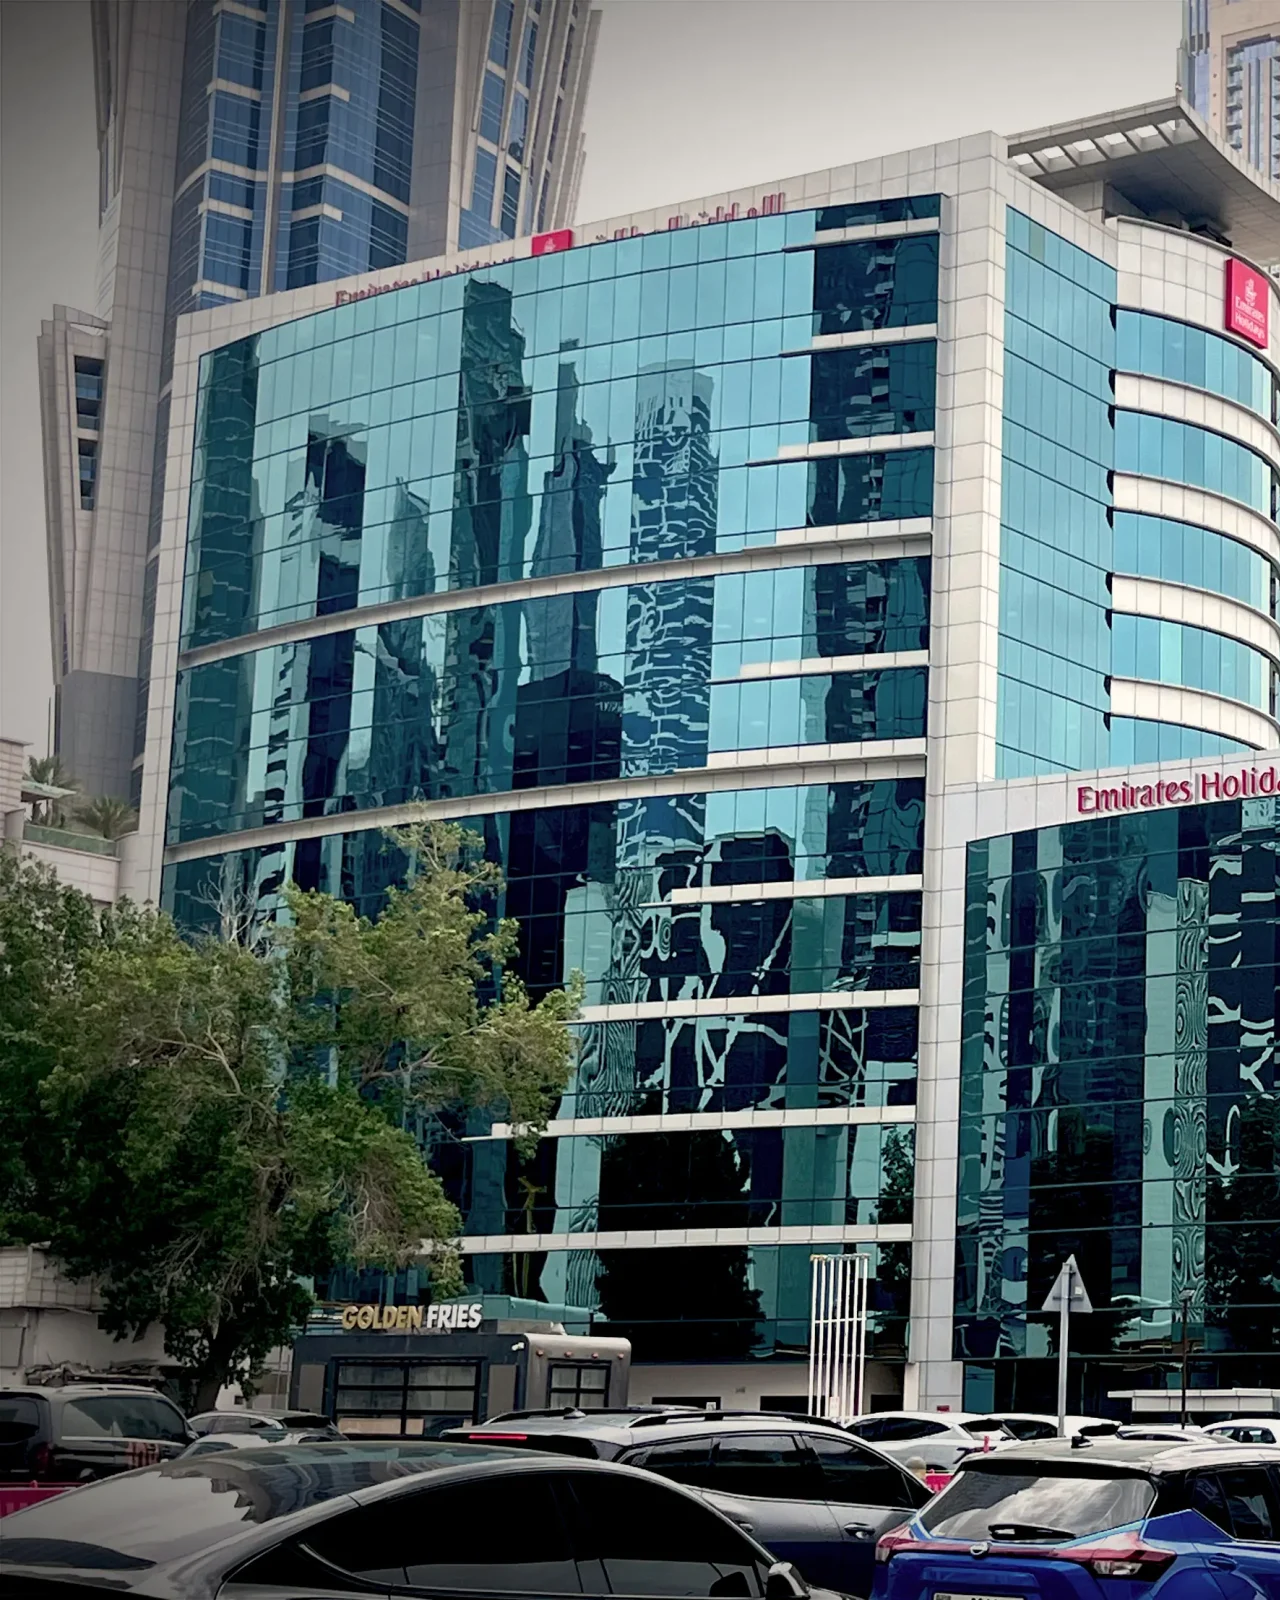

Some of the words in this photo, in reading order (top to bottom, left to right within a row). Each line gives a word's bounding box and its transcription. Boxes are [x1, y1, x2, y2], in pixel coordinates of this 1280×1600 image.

[1077, 779, 1192, 814] Emirates
[342, 1304, 424, 1330] GOLDEN
[426, 1303, 483, 1329] FRIES
